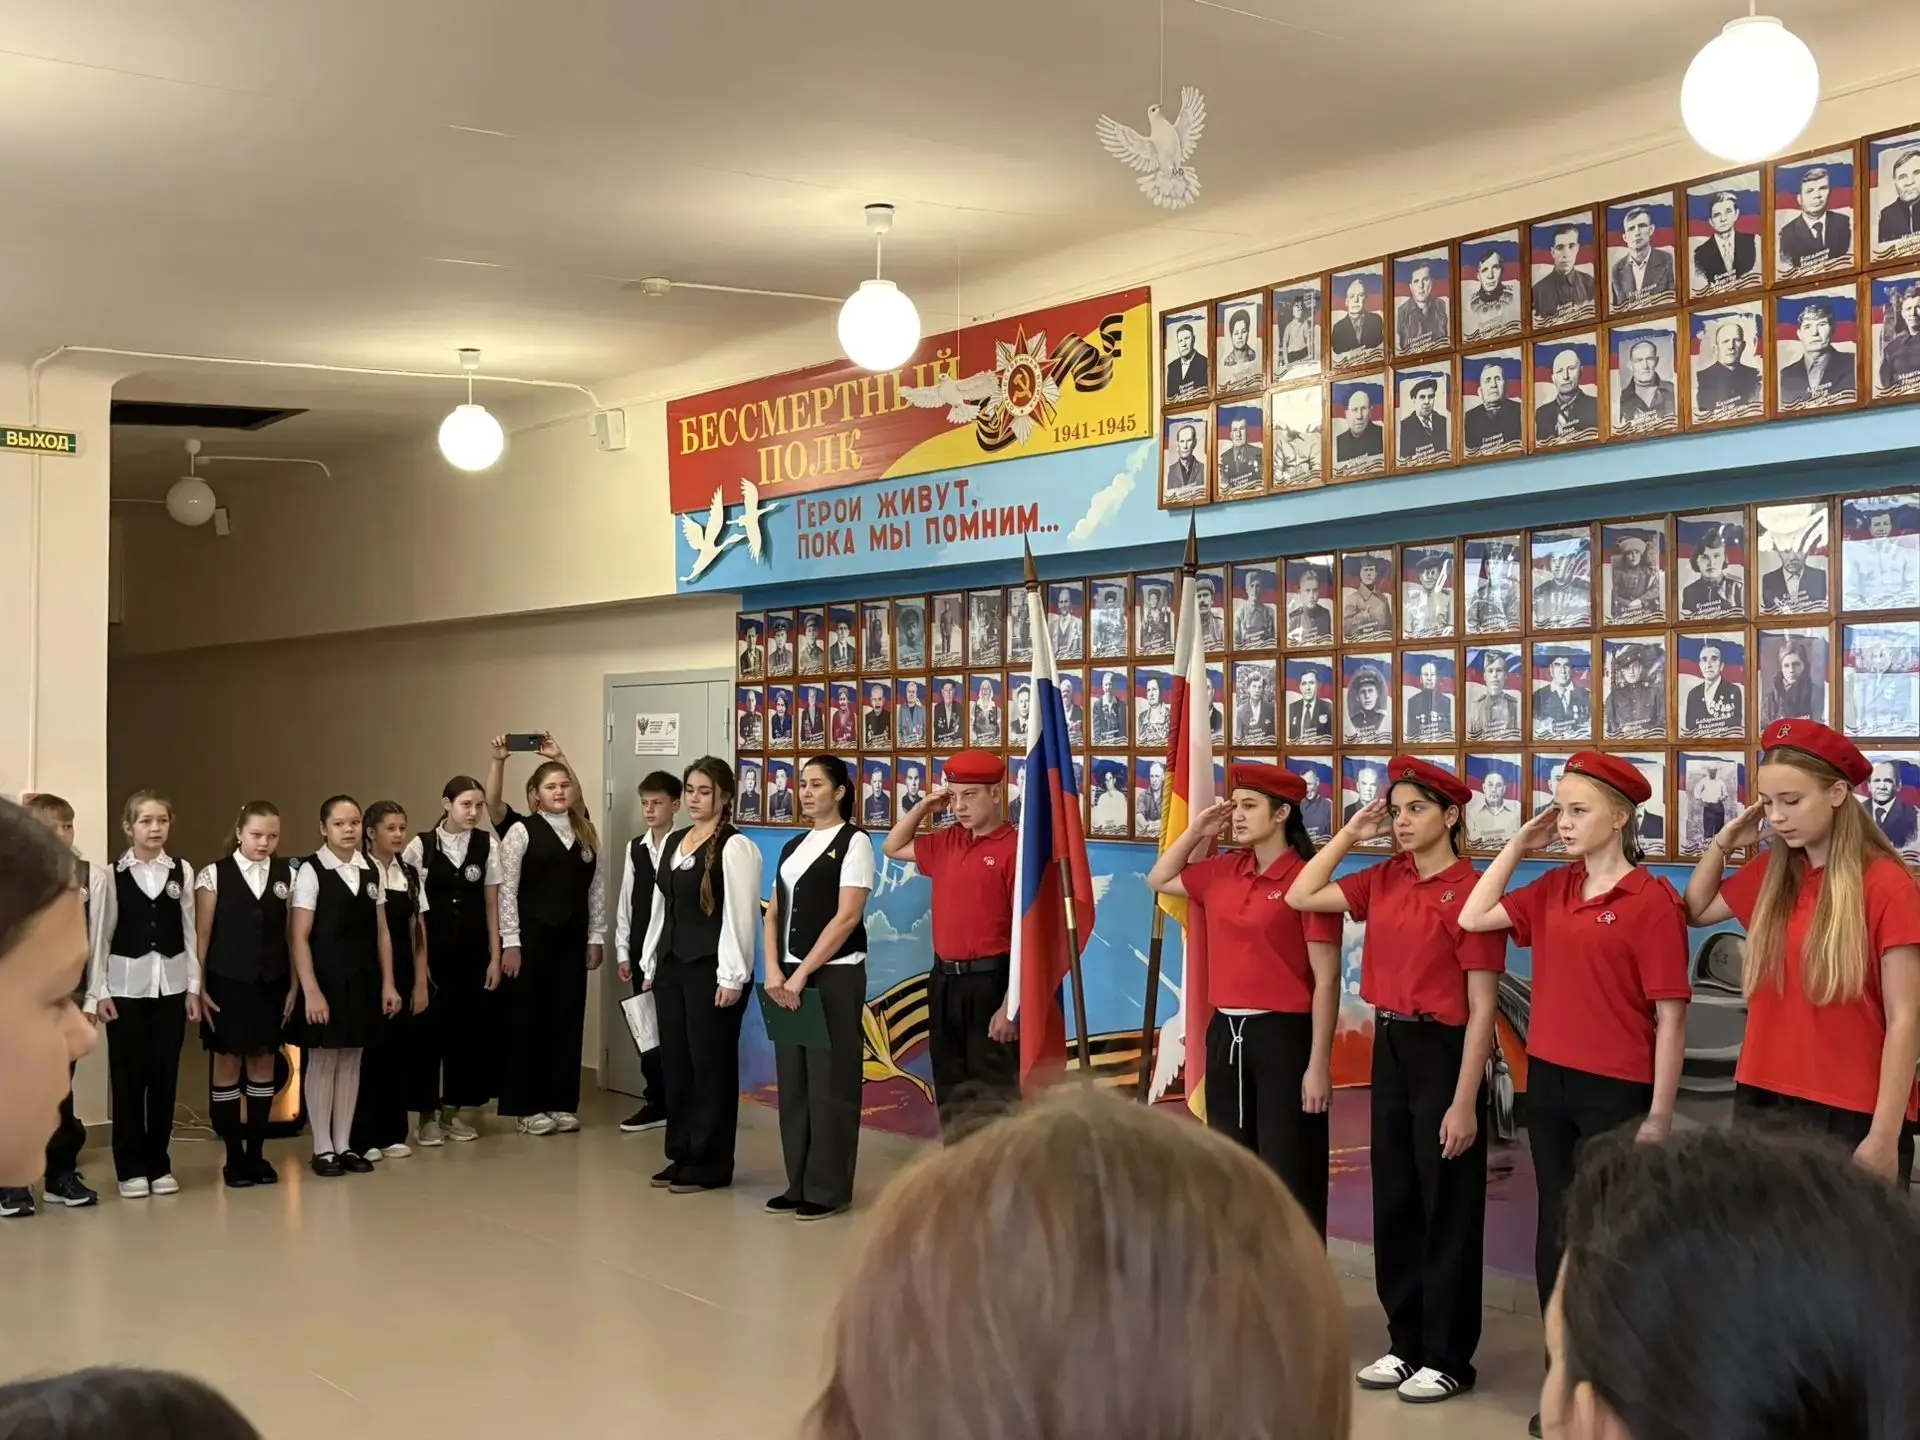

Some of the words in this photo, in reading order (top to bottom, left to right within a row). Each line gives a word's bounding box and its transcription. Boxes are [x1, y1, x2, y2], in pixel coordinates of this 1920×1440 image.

[6, 430, 70, 452] ВЫХОД
[1053, 413, 1137, 444] 1941-1945
[757, 427, 863, 486] ПОЛК
[797, 495, 862, 530] ГЕРОИ
[876, 479, 979, 520] ЖИВУТ,
[797, 527, 856, 560] ПОКА
[869, 520, 912, 552] МЫ
[925, 502, 1060, 545] ПОМНИМ...
